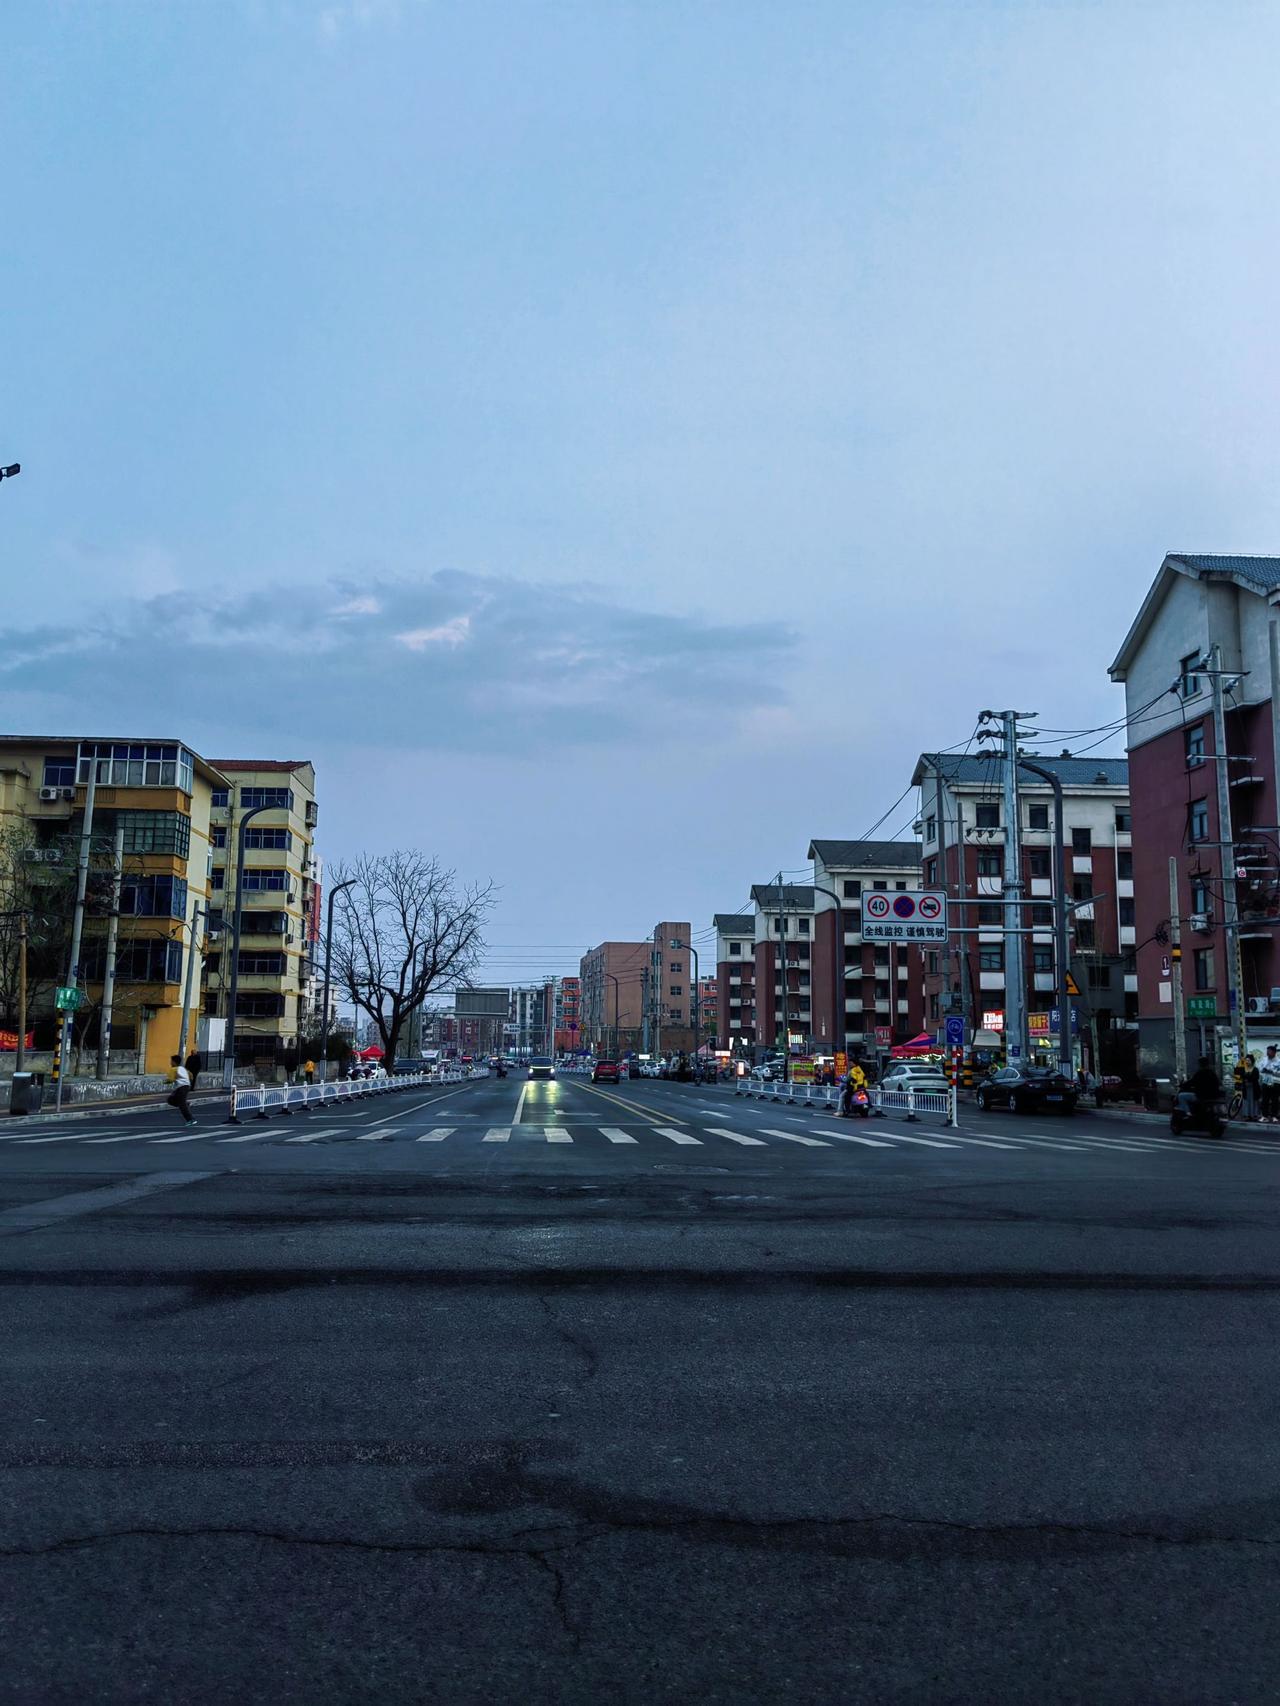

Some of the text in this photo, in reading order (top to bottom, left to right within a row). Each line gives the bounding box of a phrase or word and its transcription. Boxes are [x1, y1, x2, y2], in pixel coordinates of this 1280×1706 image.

[872, 901, 885, 911] 40
[865, 926, 944, 937] 全线监控 谨慎驾驶
